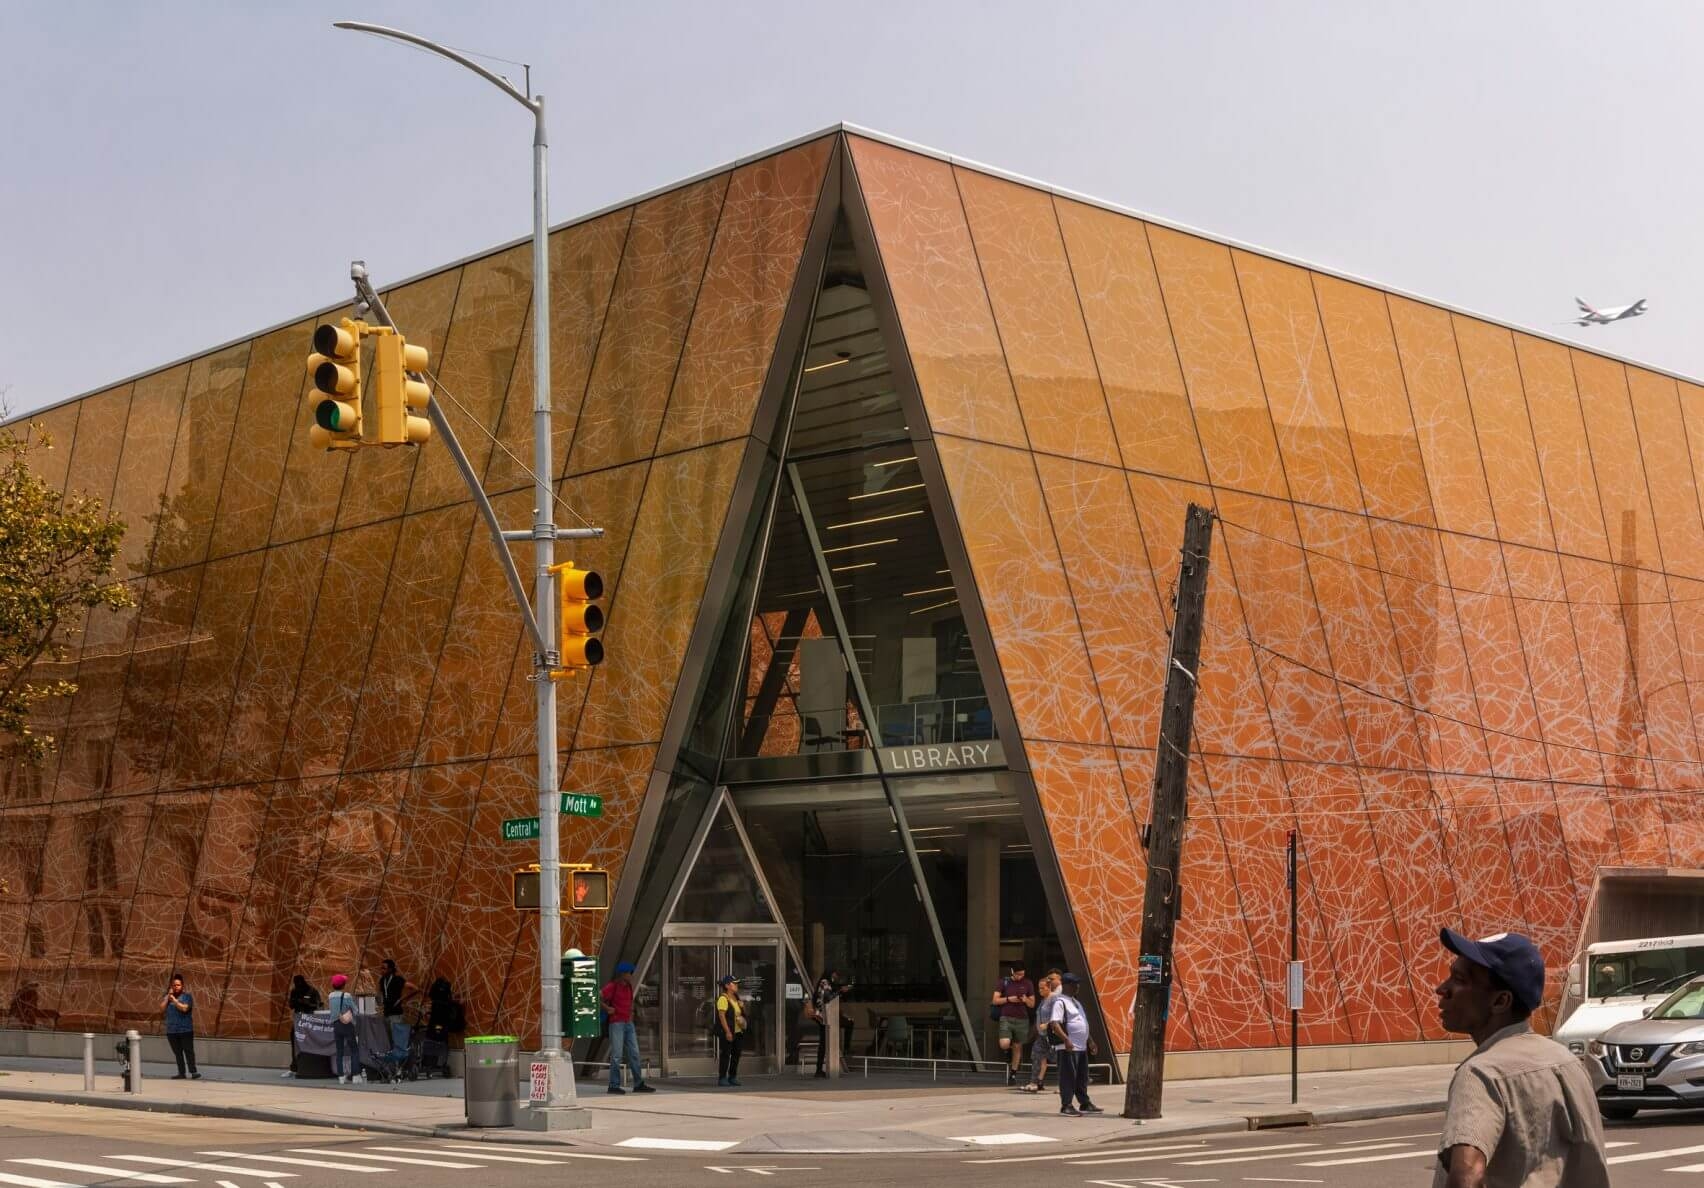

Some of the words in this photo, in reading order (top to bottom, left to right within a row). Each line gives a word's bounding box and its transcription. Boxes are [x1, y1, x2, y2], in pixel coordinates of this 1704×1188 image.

[890, 744, 990, 769] LIBRARY
[565, 796, 587, 813] Mott
[589, 799, 597, 809] Av
[506, 820, 531, 838] Central
